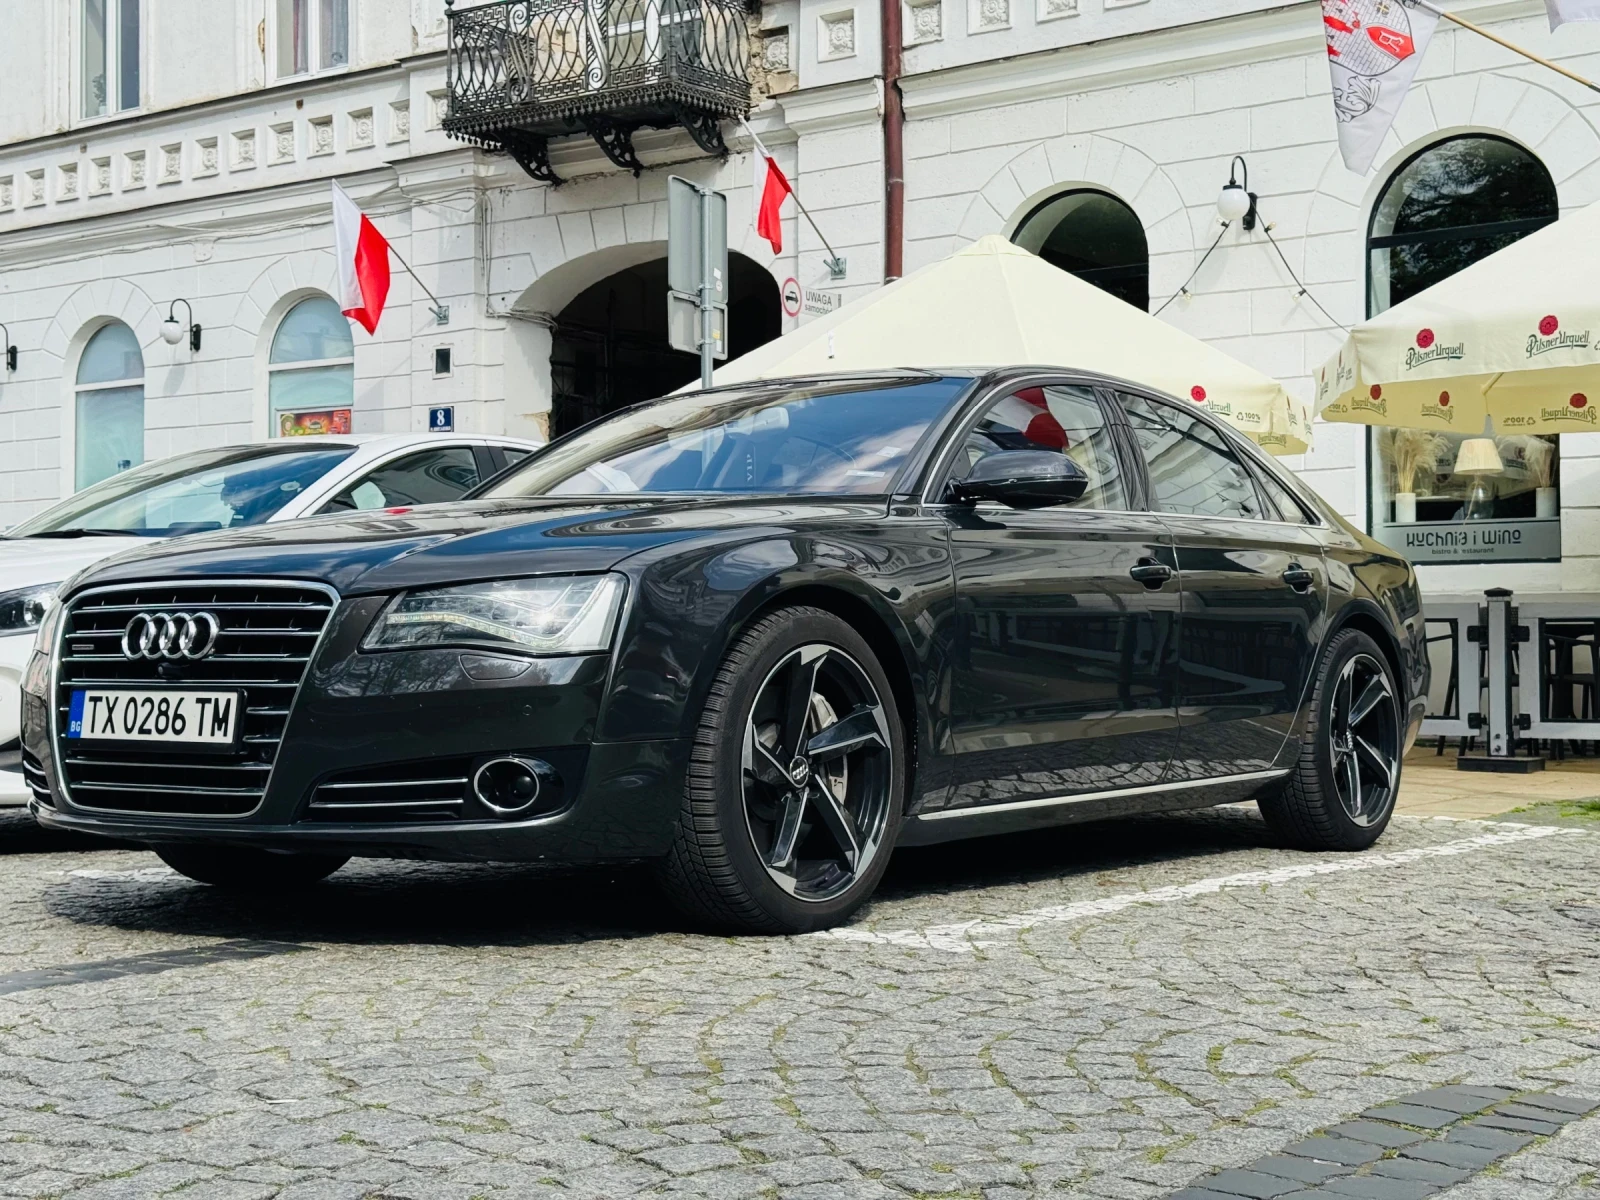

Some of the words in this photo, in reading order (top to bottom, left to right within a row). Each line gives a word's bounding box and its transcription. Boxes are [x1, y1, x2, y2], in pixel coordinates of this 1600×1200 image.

[805, 290, 832, 306] UWAGA
[1526, 333, 1560, 359] Pilsner
[1405, 346, 1436, 371] Pilsner
[436, 409, 445, 425] 8
[70, 720, 81, 732] BG
[88, 695, 119, 734] TX
[123, 696, 187, 736] 0286
[195, 697, 231, 737] TM
